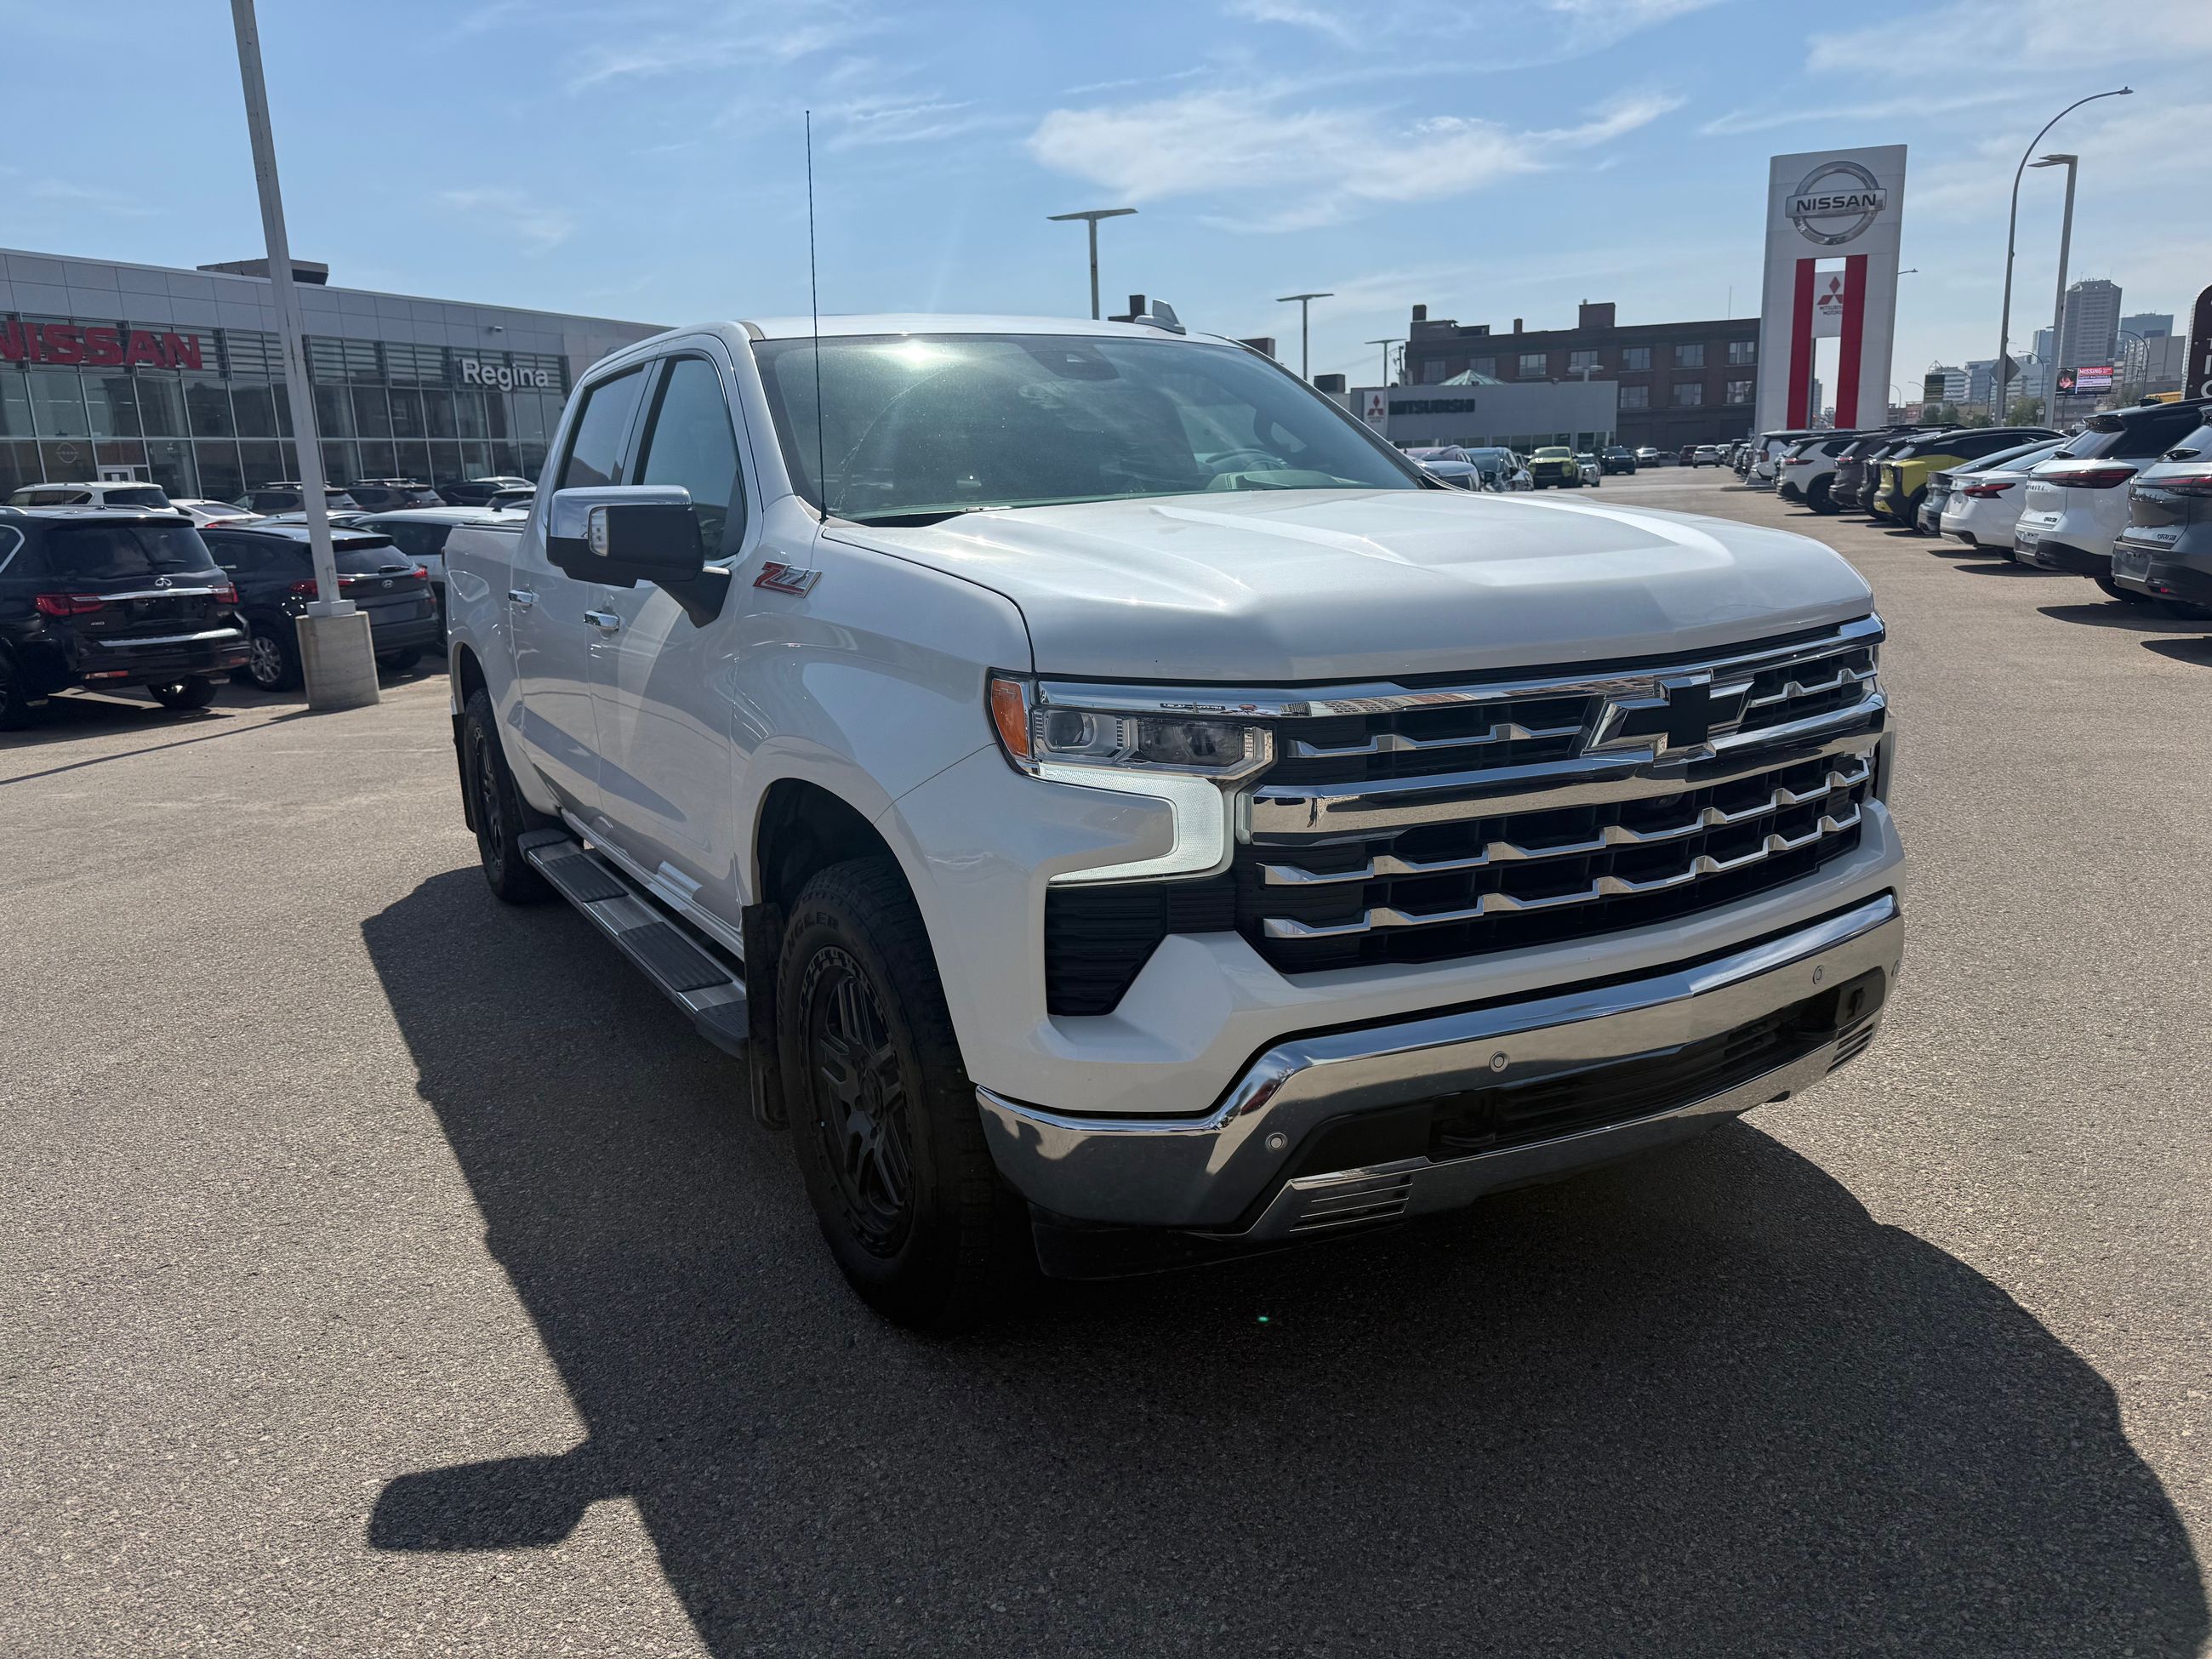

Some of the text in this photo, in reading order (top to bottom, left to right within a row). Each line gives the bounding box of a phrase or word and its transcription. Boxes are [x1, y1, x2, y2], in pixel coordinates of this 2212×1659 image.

[1796, 193, 1877, 213] NISSAN
[461, 358, 550, 391] Regina
[753, 561, 823, 599] Z71
